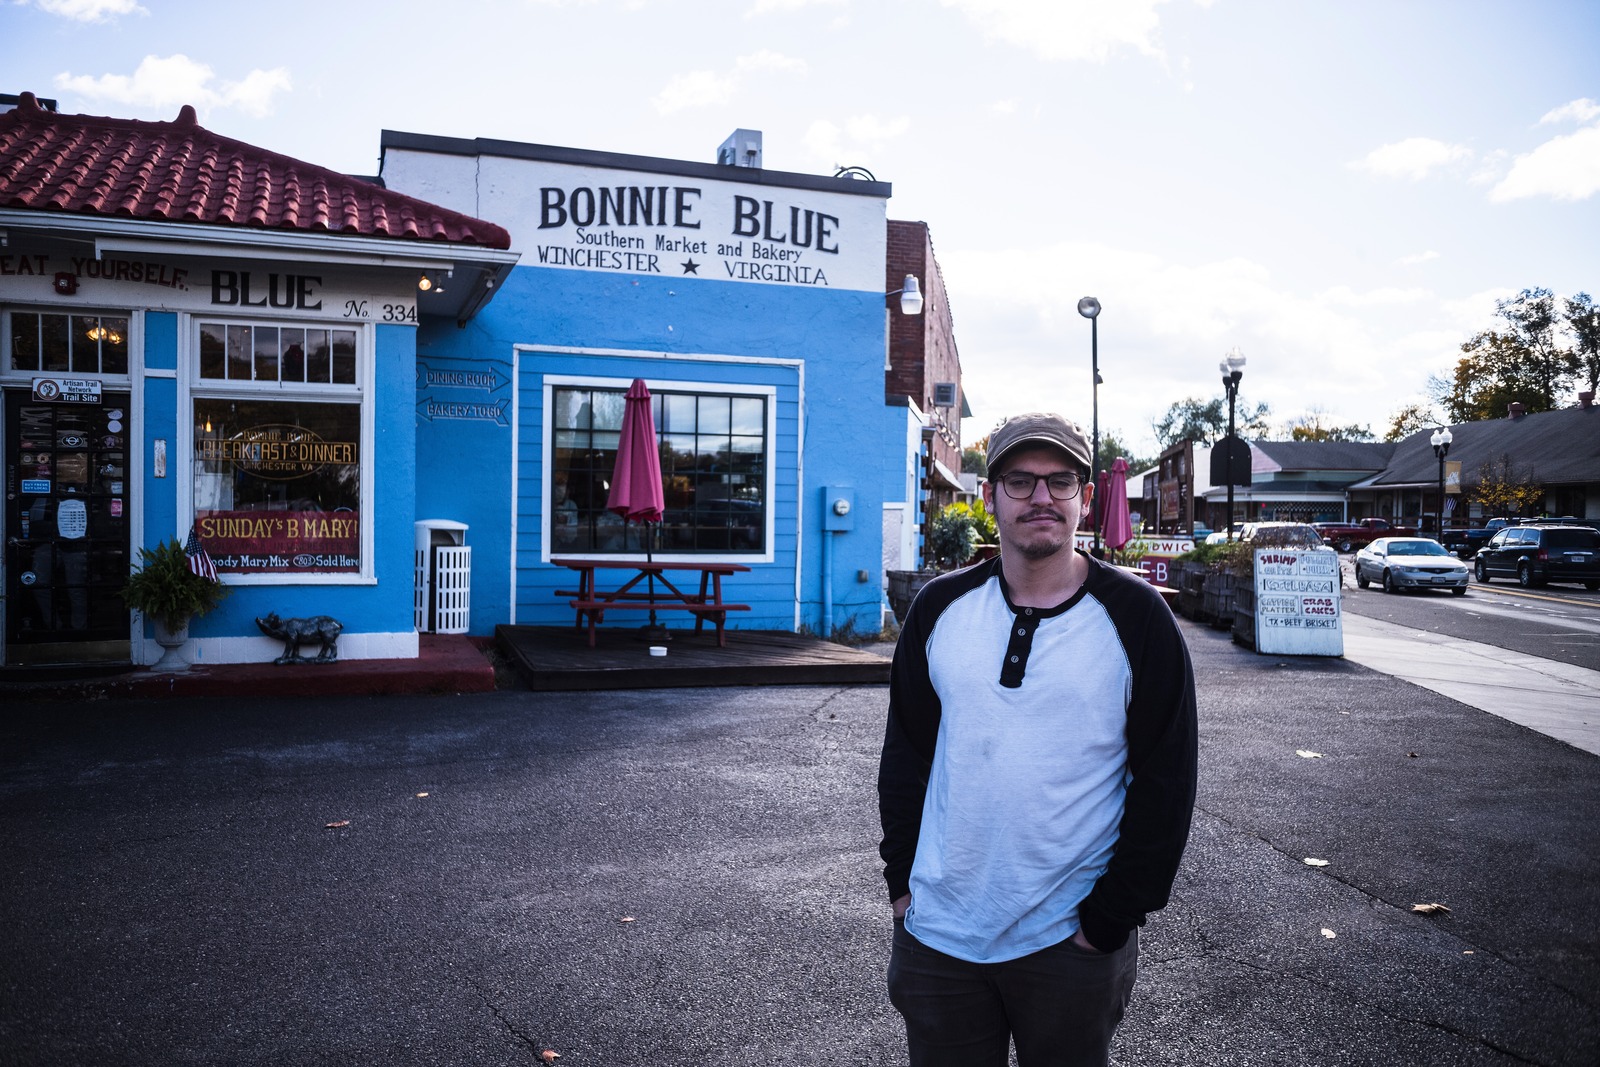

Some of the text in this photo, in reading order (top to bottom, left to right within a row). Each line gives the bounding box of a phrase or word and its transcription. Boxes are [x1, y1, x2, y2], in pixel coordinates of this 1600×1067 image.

[537, 186, 839, 254] BONNIE BLUE
[576, 227, 803, 263] Southern Market and Bakery
[537, 245, 829, 285] WINCHESTER VIRGINIA
[210, 269, 322, 310] BLUE
[382, 304, 417, 321] 334
[427, 371, 496, 387] DINING ROOM
[63, 393, 98, 402] Trail Site
[427, 404, 470, 417] BAKERY
[472, 406, 486, 418] TO
[203, 441, 352, 462] BREAKFAST & DINNER
[243, 461, 314, 472] WINCHESTER VA
[201, 518, 283, 539] SUNDAY's
[303, 519, 358, 538] MARY!
[211, 556, 238, 567] oody
[240, 555, 267, 567] Mary
[269, 556, 289, 567] Mix
[315, 556, 338, 567] Sold
[1260, 554, 1297, 566] SHRIMP
[1303, 598, 1333, 606] CRAB
[1262, 606, 1296, 614] PLATTER
[1305, 607, 1336, 616] CAKES
[1284, 619, 1302, 627] BEEF
[1305, 619, 1336, 628] BRISKET
